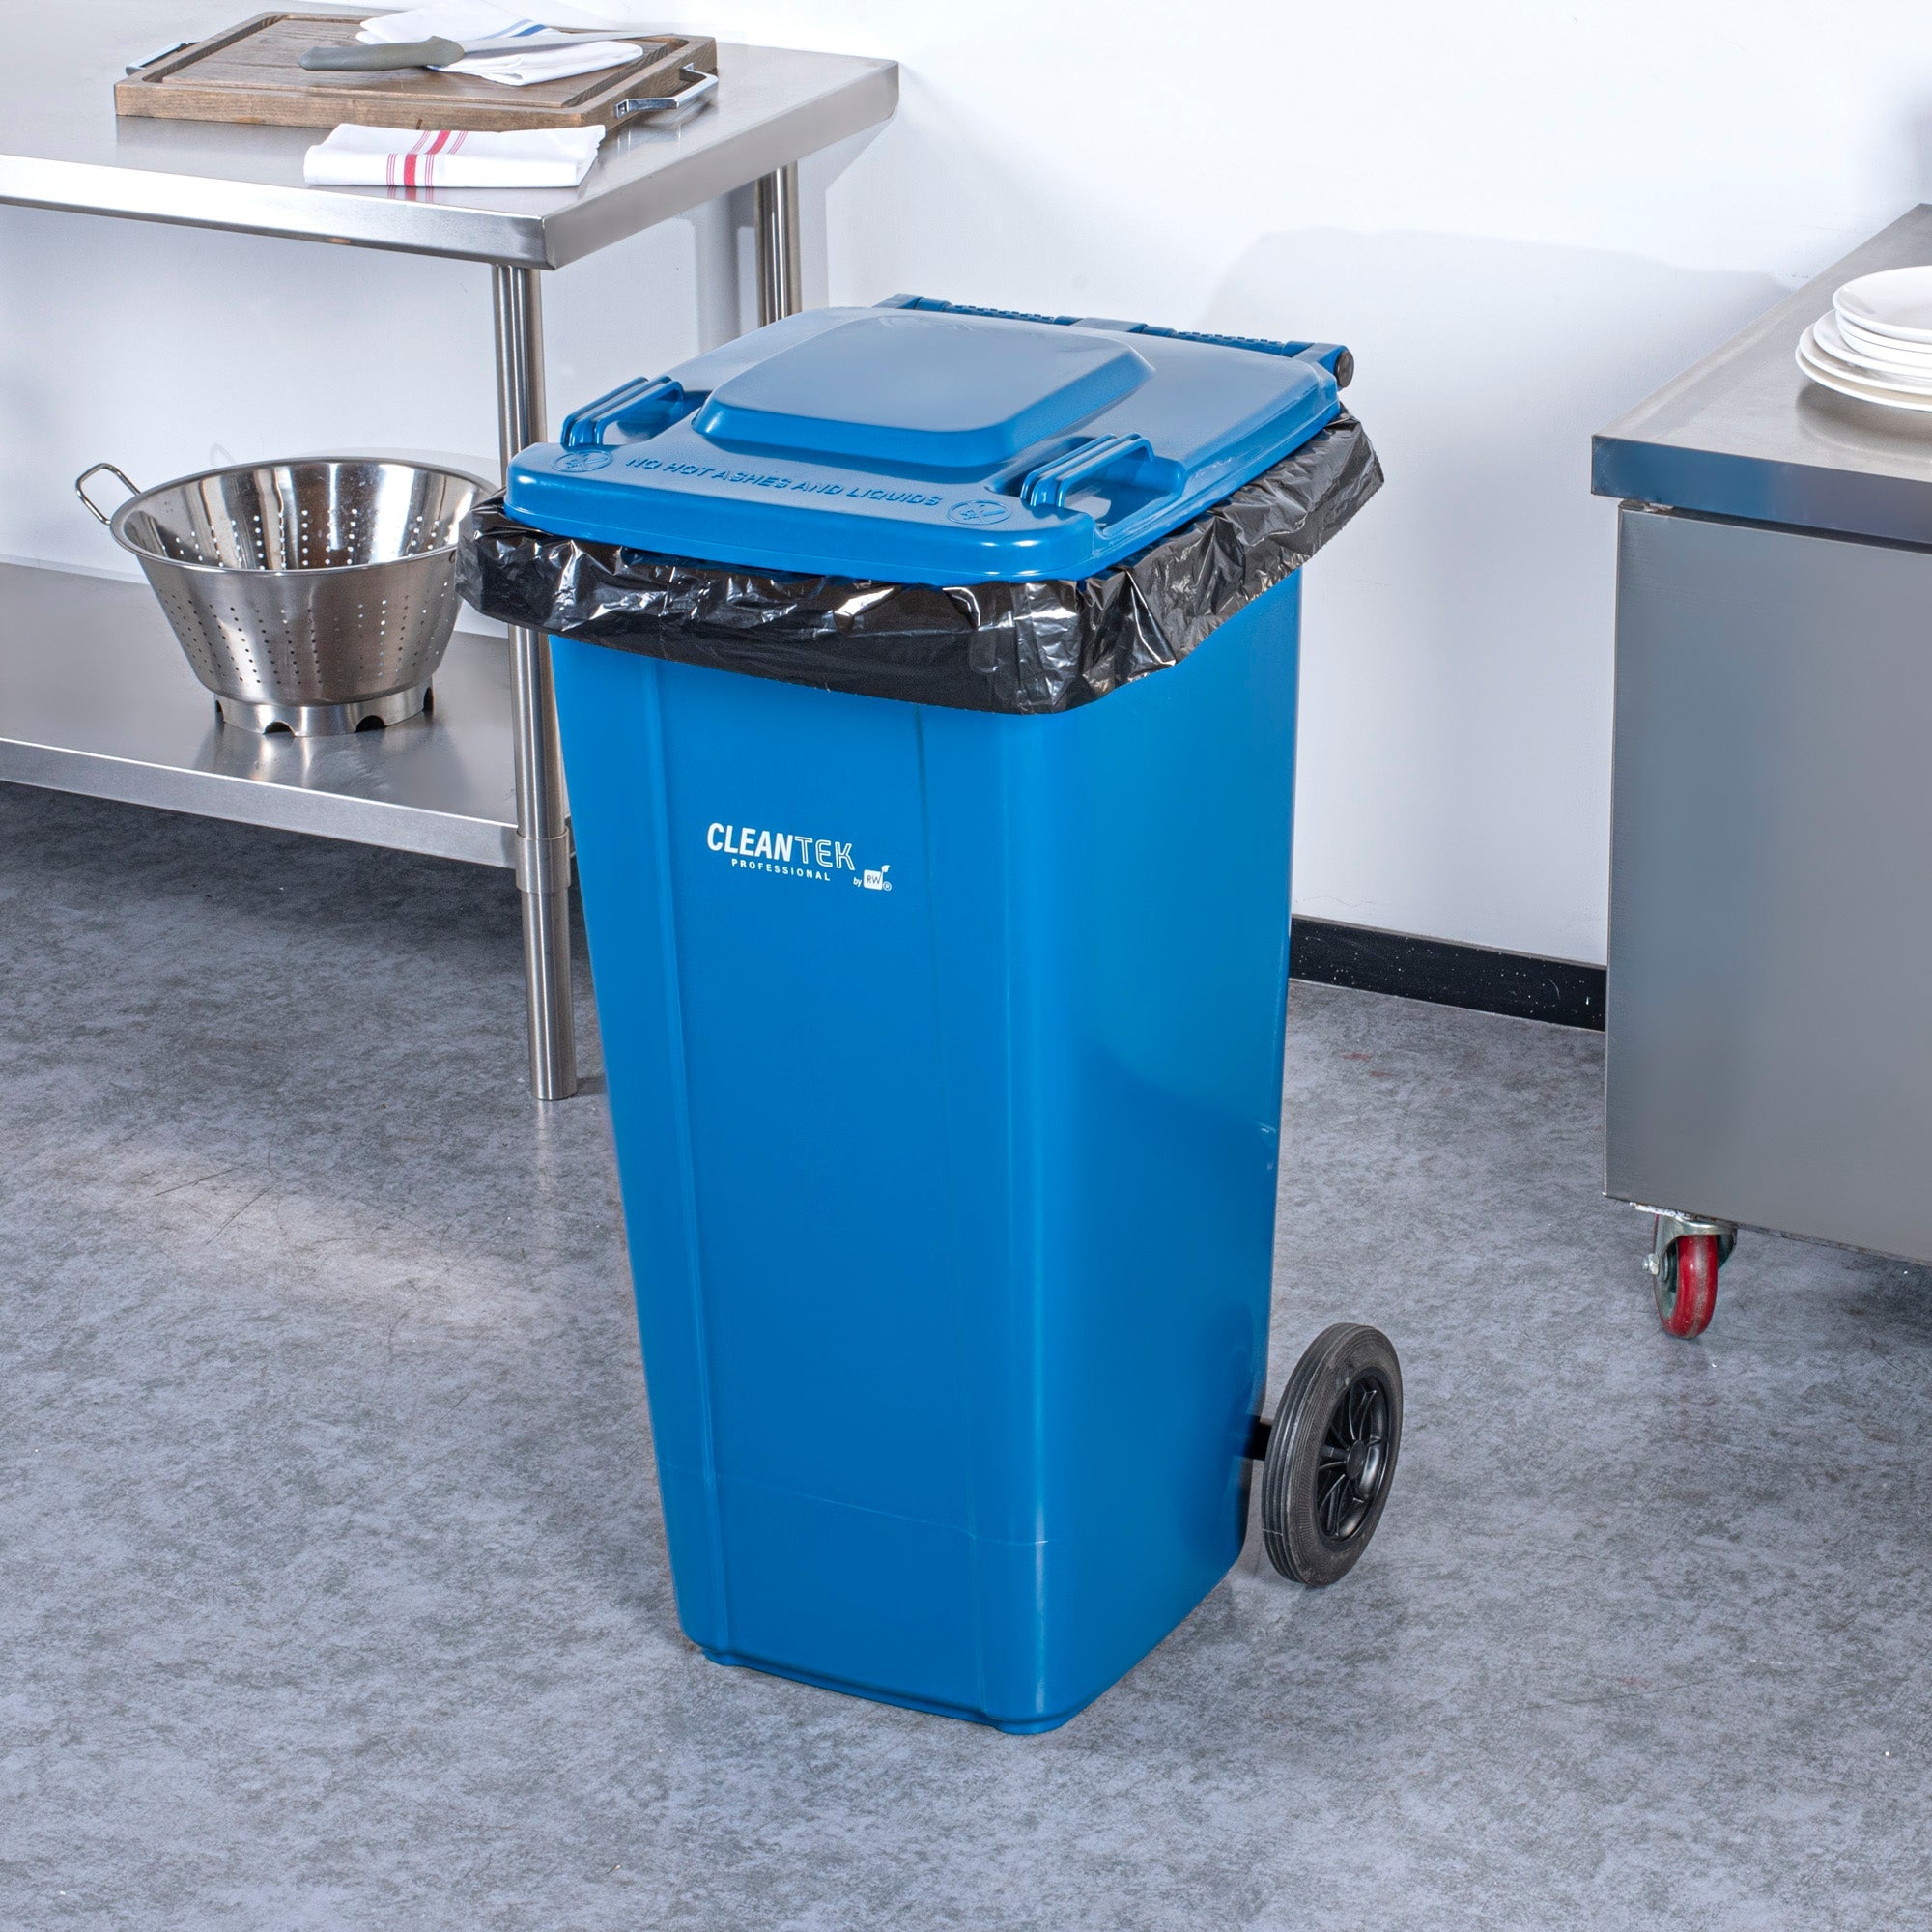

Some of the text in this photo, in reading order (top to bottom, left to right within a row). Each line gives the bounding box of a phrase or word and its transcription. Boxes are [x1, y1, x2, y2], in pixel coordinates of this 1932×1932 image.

[626, 456, 943, 506] NO HOT ASHES AND LIQUIDS
[707, 822, 855, 871] CLEANTEK
[731, 858, 831, 882] PROFESSIONAL
[853, 876, 863, 888] by
